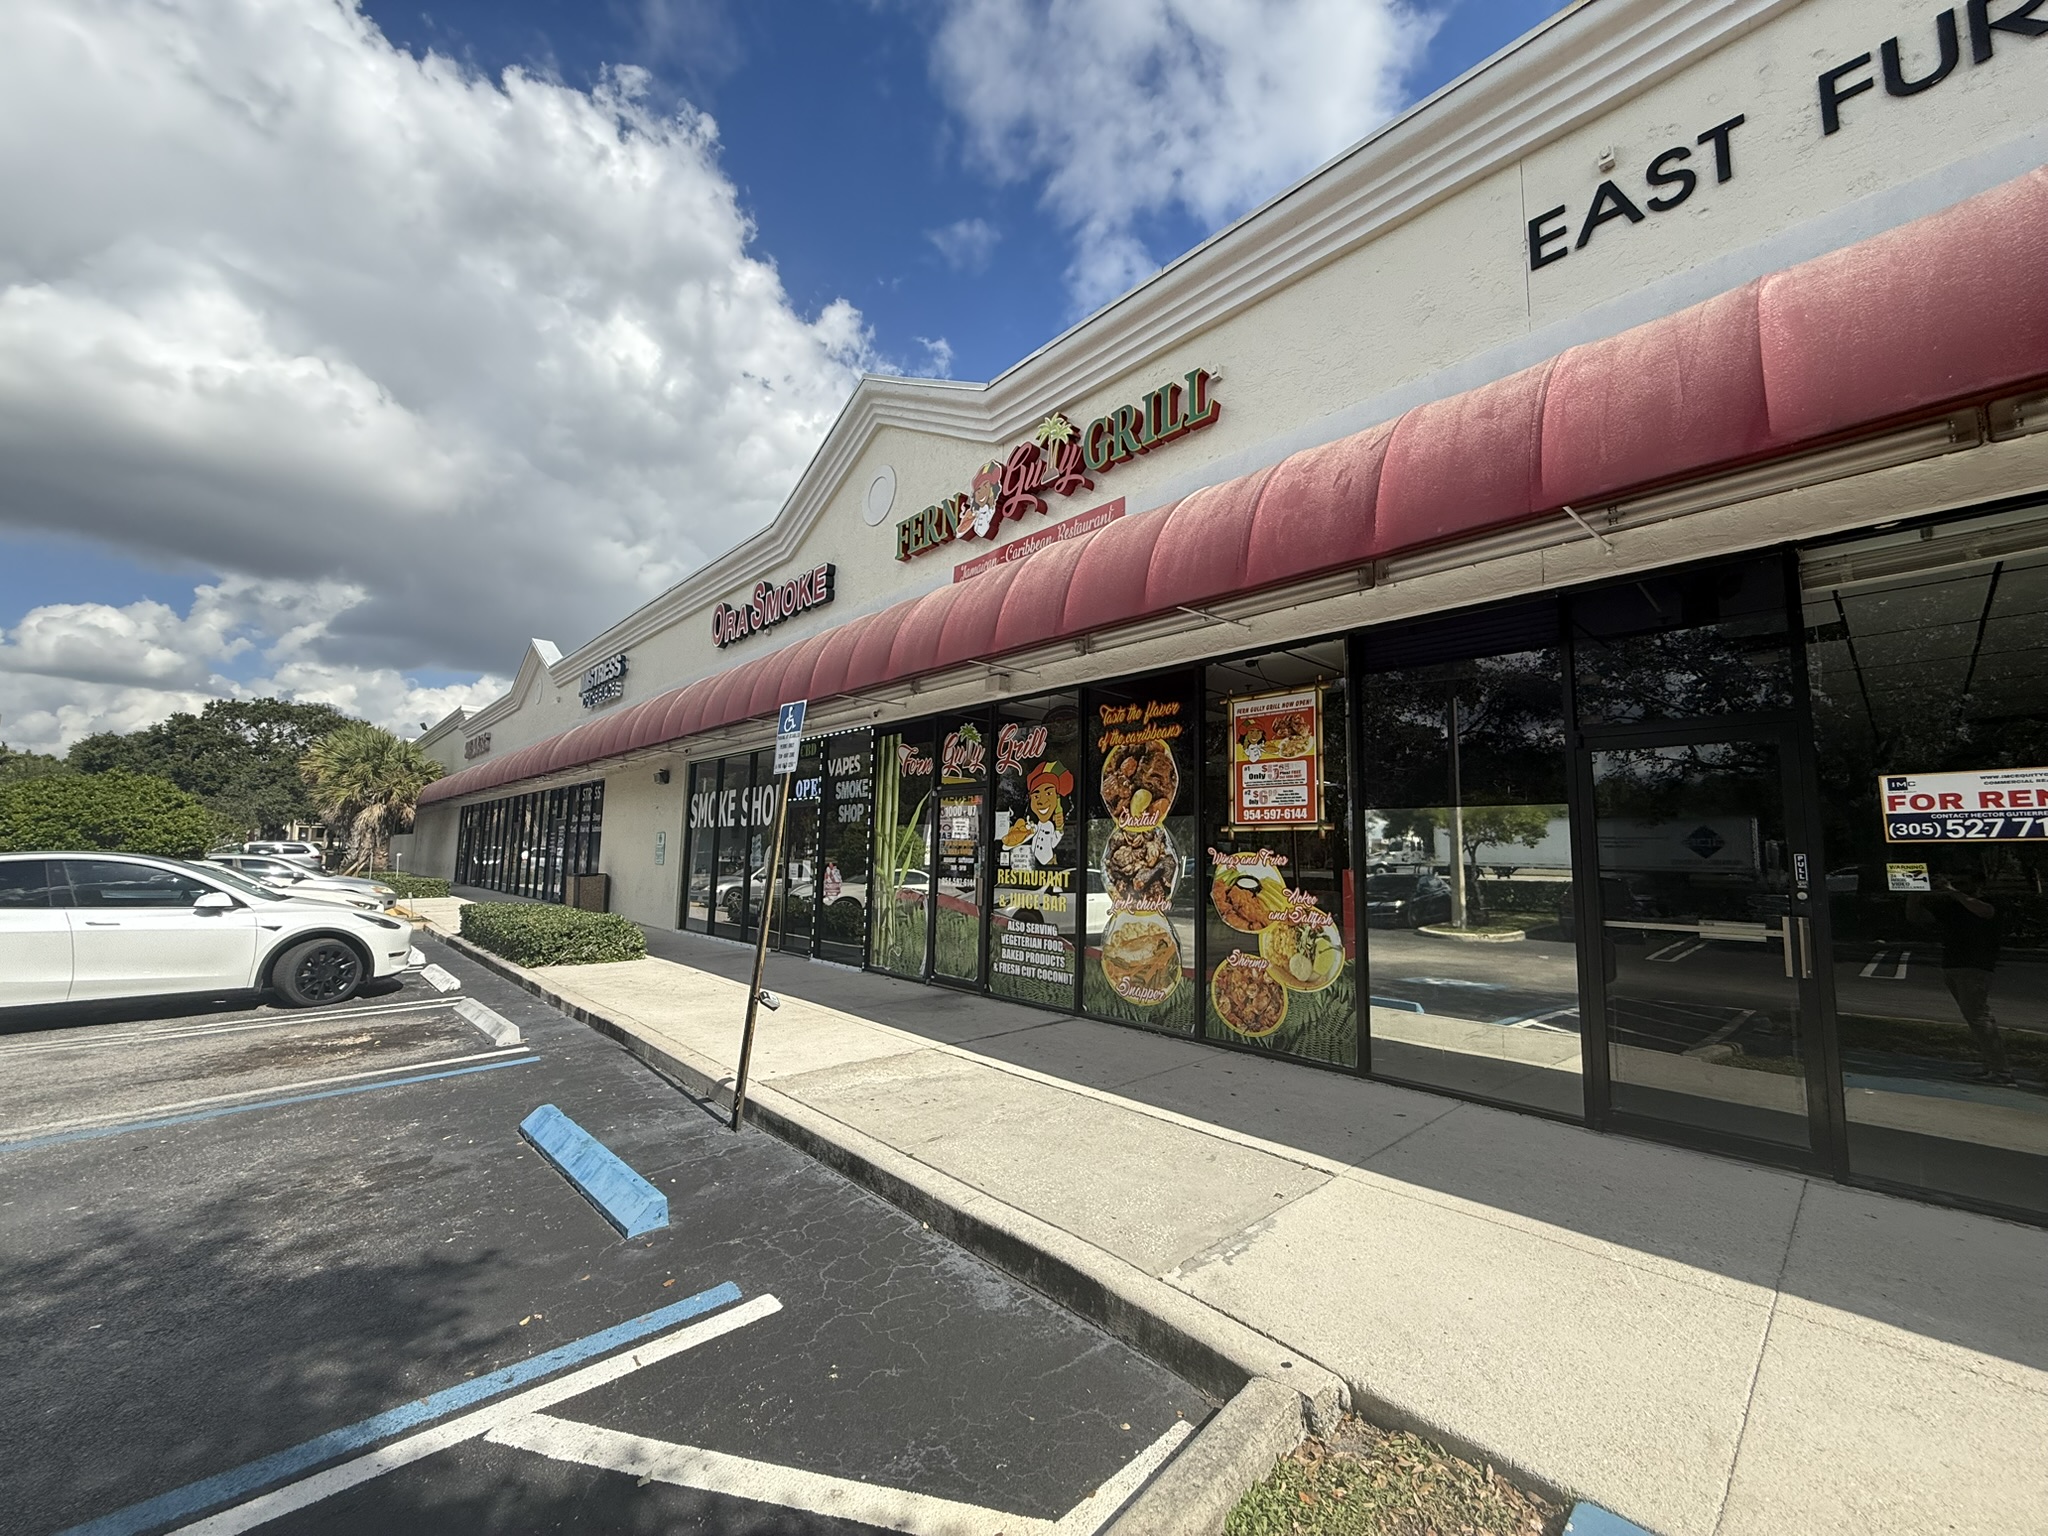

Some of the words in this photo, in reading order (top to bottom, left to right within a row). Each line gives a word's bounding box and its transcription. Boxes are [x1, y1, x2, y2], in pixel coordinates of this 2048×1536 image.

[1528, 113, 1745, 271] EAST
[895, 492, 970, 562] FERN
[1083, 367, 1221, 474] GRILL
[1057, 505, 1115, 542] Restaurant
[1099, 704, 1126, 727] Taste
[1126, 702, 1143, 723] the
[1143, 700, 1180, 725] flavor
[1266, 703, 1281, 711] GRILL
[1281, 701, 1295, 709] NOW
[801, 742, 817, 757] CBD
[995, 722, 1049, 777] Grill
[1097, 730, 1110, 754] of
[1109, 728, 1125, 747] the
[827, 754, 861, 777] VAPES
[795, 777, 822, 798] OPE
[835, 778, 869, 801] SMOKE
[1891, 780, 1916, 788] IMC
[689, 788, 737, 830] SMOKE
[740, 784, 780, 827] SHO
[838, 803, 865, 823] SHOP
[1243, 807, 1308, 820] 954-597-6144
[1887, 792, 1965, 812] FOR
[1888, 821, 1942, 839] (305)
[1207, 847, 1240, 870] Wings
[1240, 852, 1259, 866] and
[1259, 847, 1289, 867] Fries
[1797, 855, 1806, 880] PULL
[996, 868, 1071, 888] RESTAURANT
[999, 893, 1007, 907] &
[1009, 892, 1041, 910] JUICE
[1043, 894, 1068, 913] BAR
[1136, 894, 1173, 917] chicken
[1282, 886, 1319, 906] Ackee
[1268, 909, 1289, 921] and
[1288, 905, 1334, 928] Saltfish
[1007, 920, 1025, 932] ALSO
[1025, 922, 1058, 937] SERVING
[1000, 933, 1043, 950] VEGETERIAN
[1001, 948, 1025, 961] BAKED
[1025, 950, 1066, 968] PRODUCTS
[993, 962, 999, 972] &
[999, 961, 1020, 976] FRESH
[1021, 965, 1036, 979] CUT
[1036, 967, 1074, 986] COCONUT
[1116, 976, 1165, 1003] Snapper
